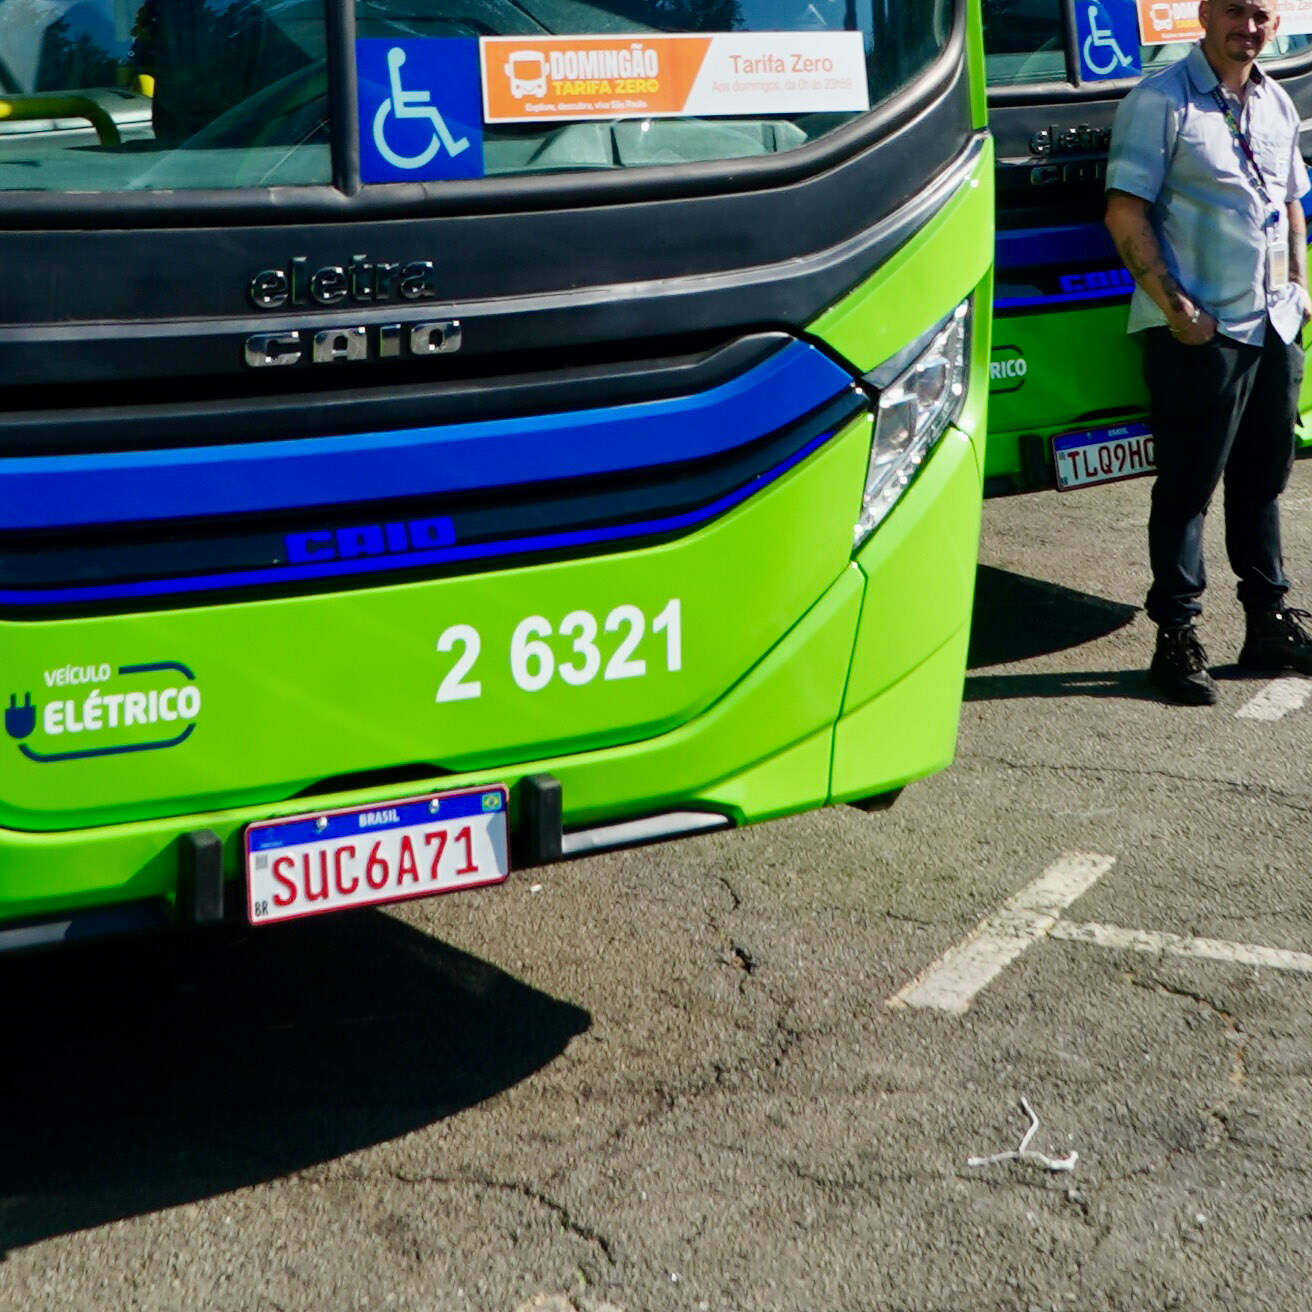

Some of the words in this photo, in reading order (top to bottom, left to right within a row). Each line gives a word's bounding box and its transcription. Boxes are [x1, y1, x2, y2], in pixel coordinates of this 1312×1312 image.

[549, 43, 659, 80] DOMINGÃO
[729, 54, 785, 74] Tarifa
[791, 53, 833, 73] Zero
[552, 80, 613, 96] TARIFA
[615, 78, 660, 94] ZERO
[250, 254, 436, 309] eletra
[245, 320, 463, 368] CAIO
[990, 358, 1028, 380] RICO
[285, 516, 457, 564] CAIO
[435, 623, 482, 704] 2
[509, 598, 683, 693] 6321
[43, 663, 112, 688] VEÍCULO
[43, 685, 202, 736] ELÉTRICO
[358, 808, 401, 829] BRASIL
[271, 825, 479, 908] SUC6A71
[254, 899, 269, 918] BR
